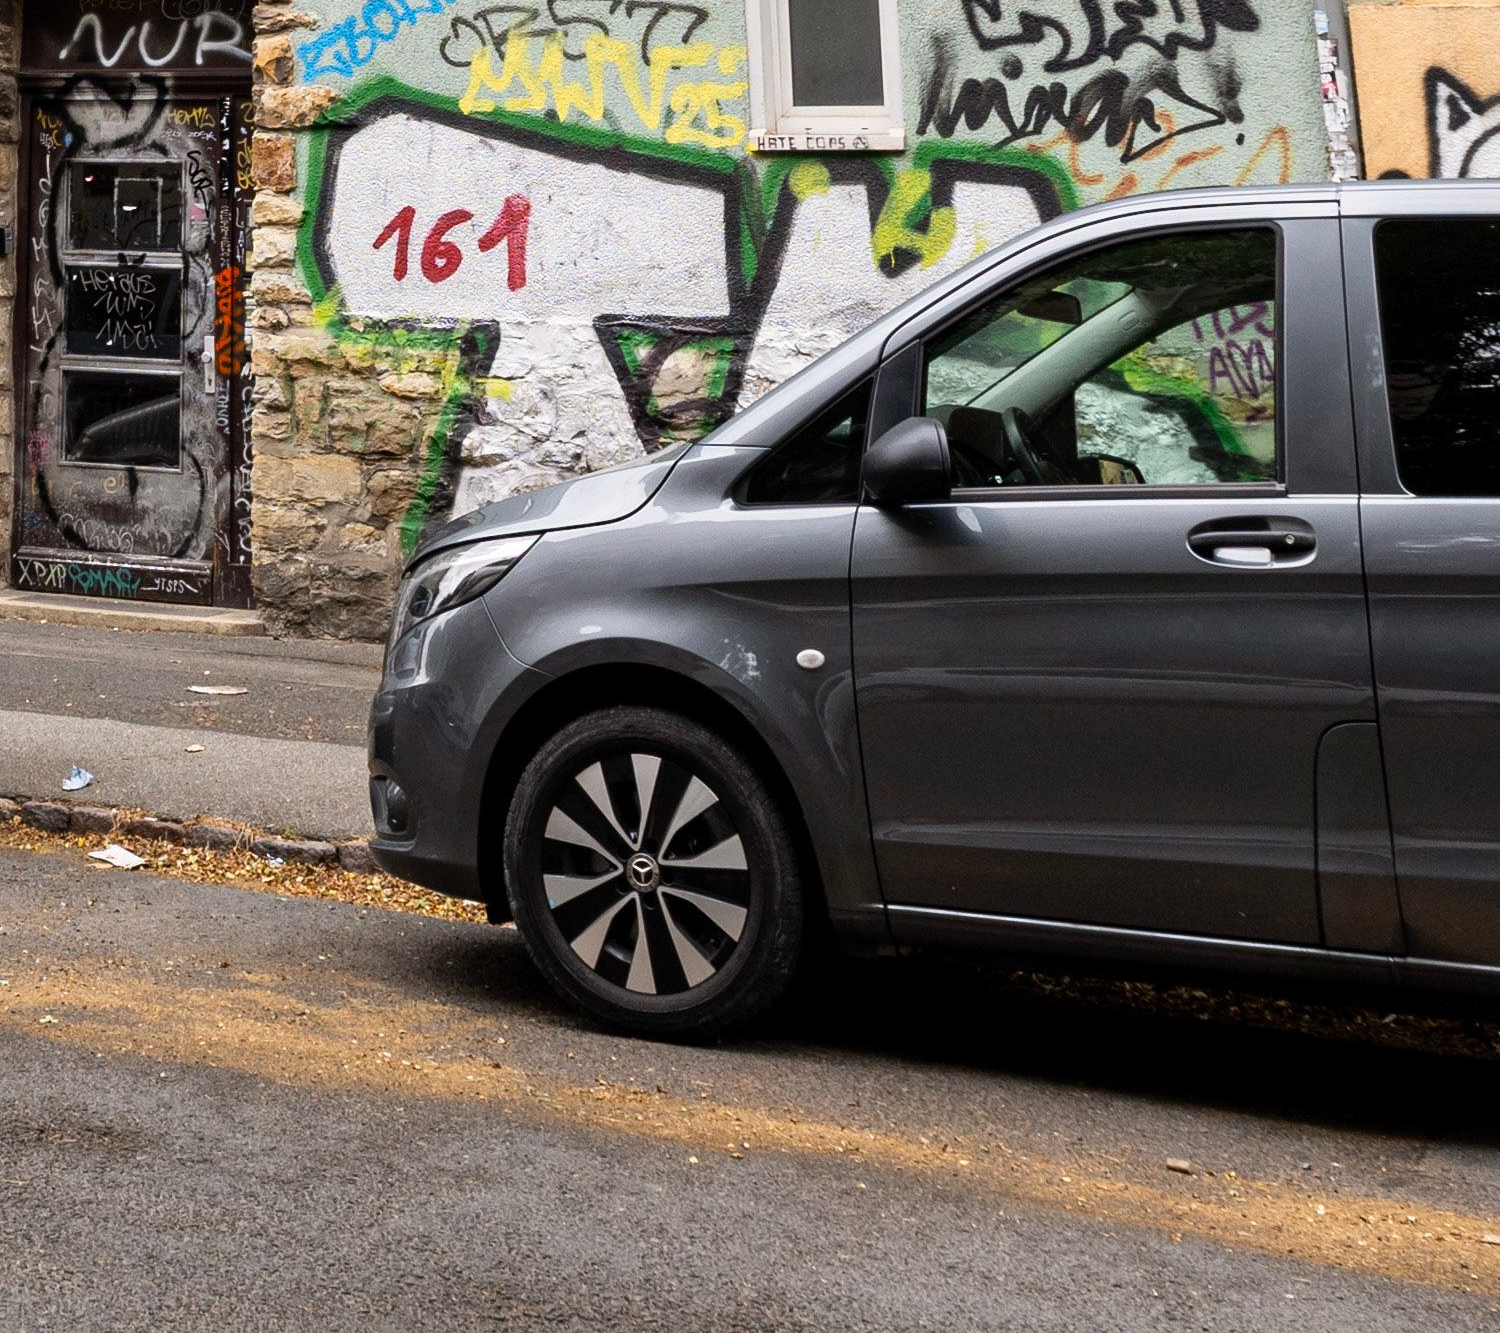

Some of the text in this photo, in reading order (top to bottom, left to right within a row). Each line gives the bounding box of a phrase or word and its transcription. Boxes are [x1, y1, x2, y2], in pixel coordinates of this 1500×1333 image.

[58, 13, 253, 67] NUR
[757, 136, 846, 151] HATE COPS
[373, 193, 532, 291] 161
